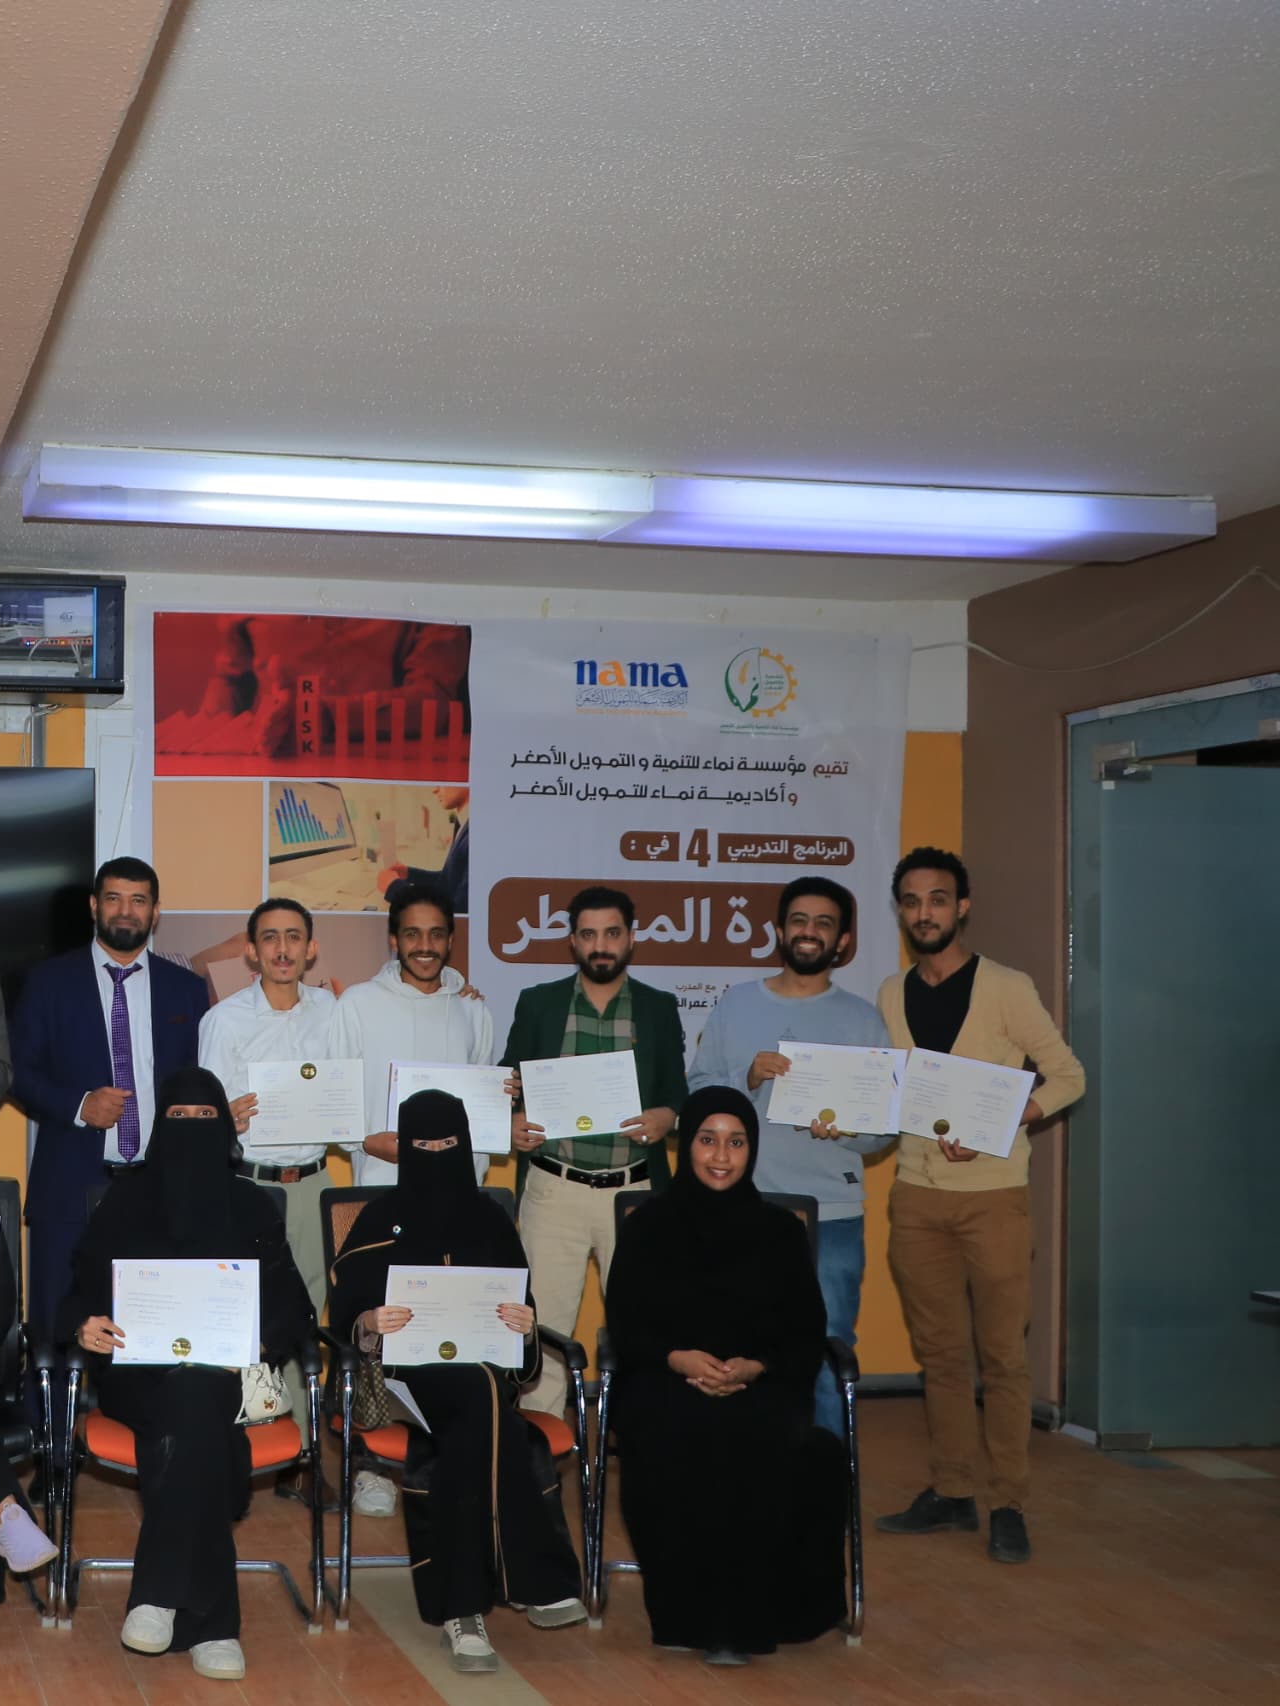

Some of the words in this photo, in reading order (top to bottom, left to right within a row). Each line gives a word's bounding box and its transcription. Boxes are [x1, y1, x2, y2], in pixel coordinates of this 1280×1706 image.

[573, 659, 688, 688] nama
[302, 680, 314, 753] RISK
[511, 745, 566, 768] الأصغر
[570, 751, 635, 770] التمويل
[638, 757, 649, 771] و
[652, 754, 700, 773] للتنمية
[702, 755, 734, 771] نماء
[737, 754, 806, 776] مؤسسة
[812, 760, 849, 778] تقيم
[510, 776, 573, 799] الأصغر
[576, 782, 648, 801] للتمويل
[650, 784, 694, 801] نماء
[646, 835, 670, 859] في
[686, 828, 711, 868] 4
[727, 839, 788, 861] التدريبي
[793, 840, 848, 861] البرنامج
[502, 894, 711, 954] المطر
